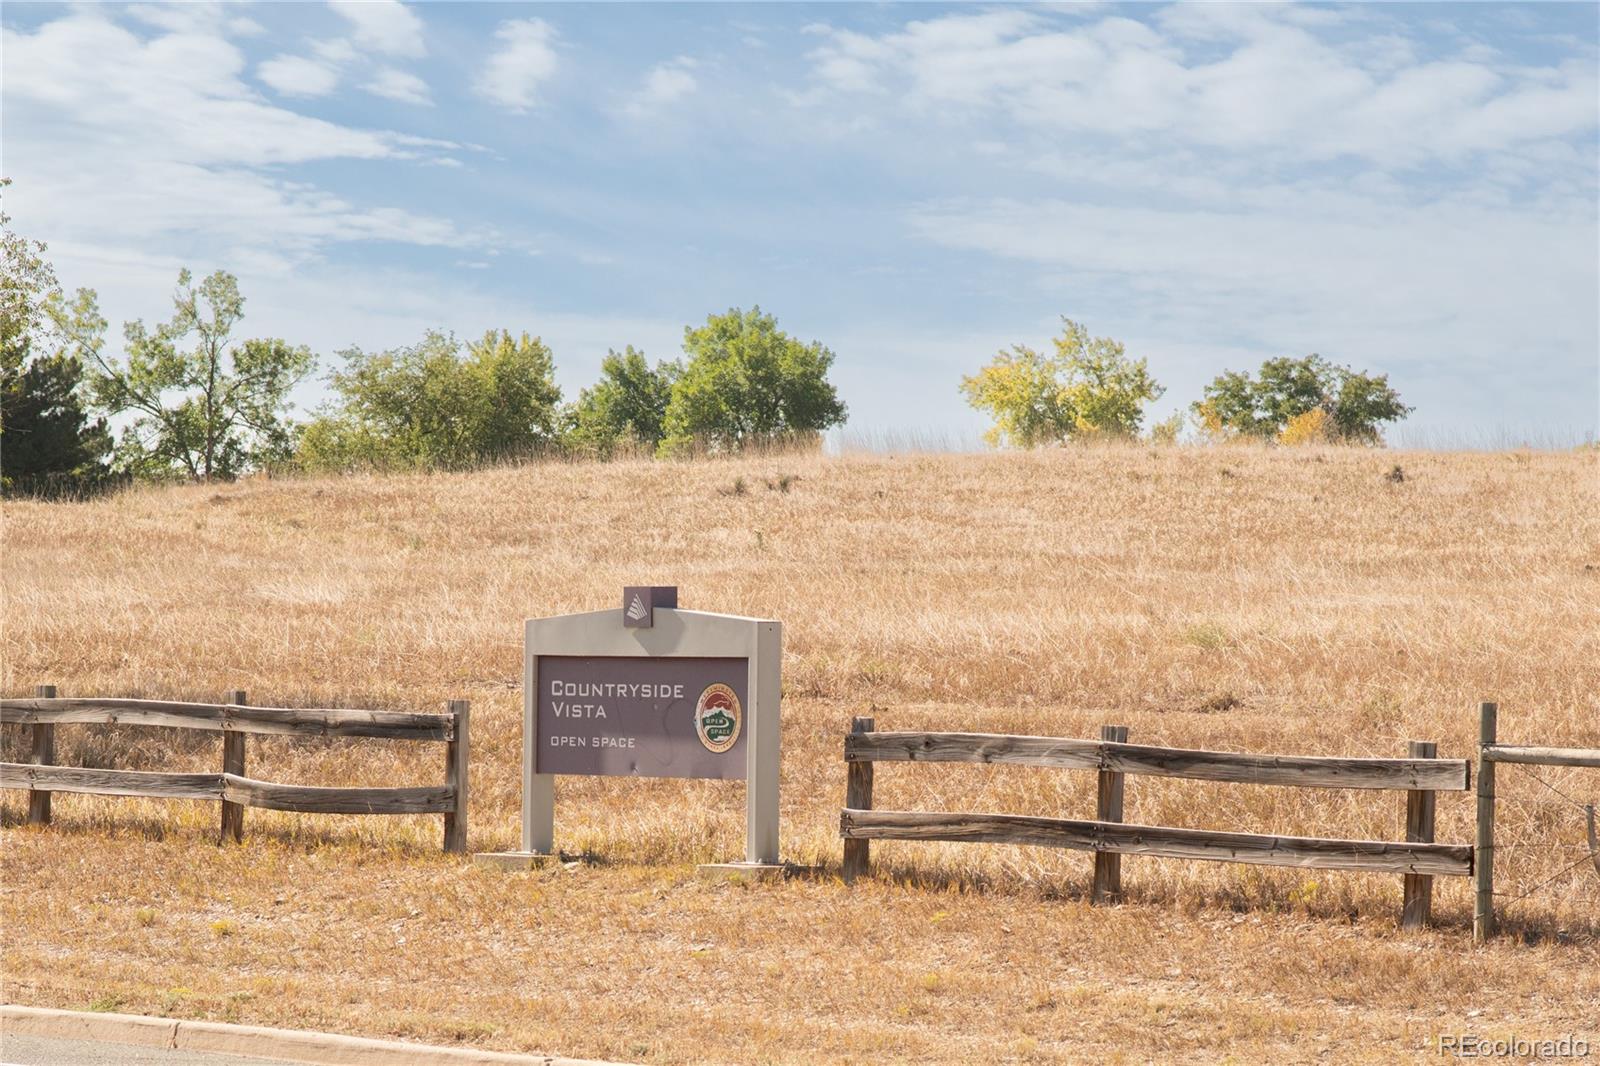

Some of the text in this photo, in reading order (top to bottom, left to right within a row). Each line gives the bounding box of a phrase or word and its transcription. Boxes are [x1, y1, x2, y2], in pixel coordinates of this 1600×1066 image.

[551, 680, 684, 698] COUNTRYSIDE
[551, 701, 607, 719] VISTA
[550, 735, 635, 748] OPEN SPACE
